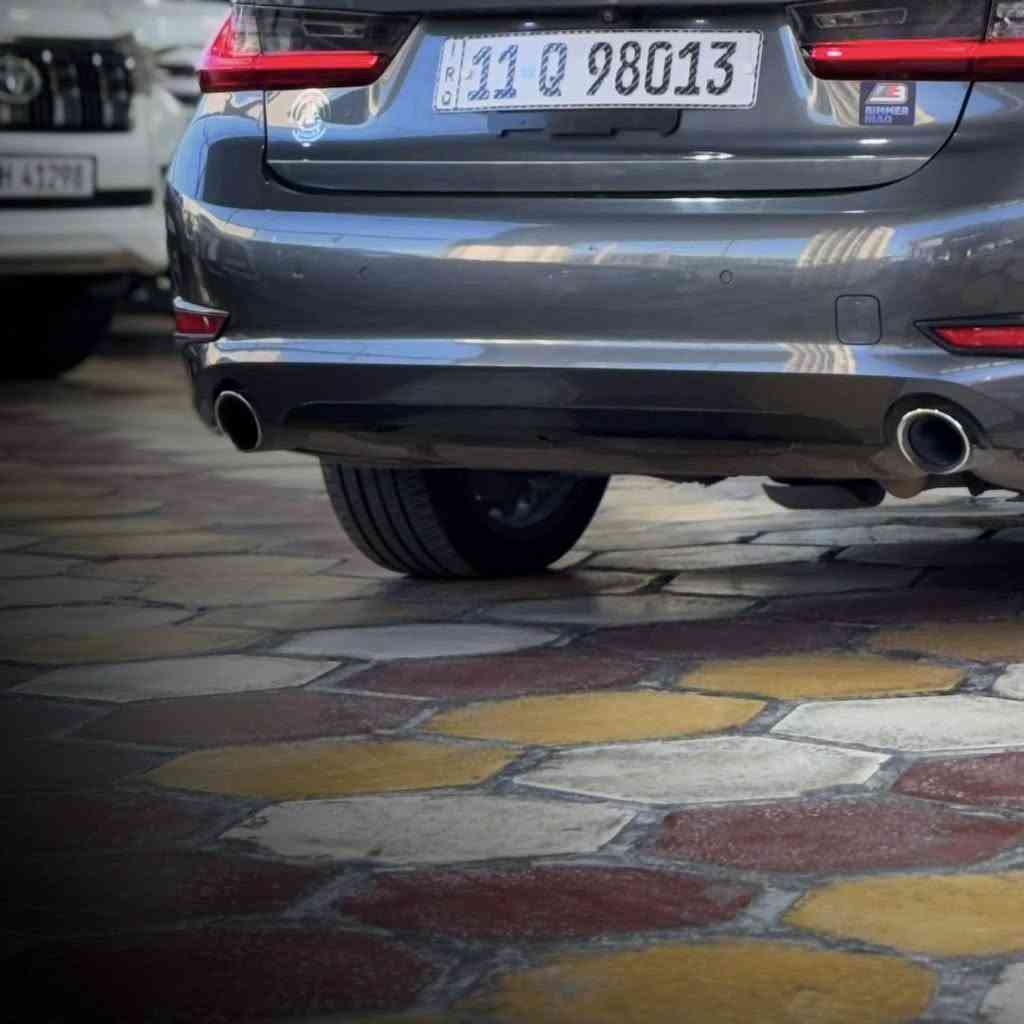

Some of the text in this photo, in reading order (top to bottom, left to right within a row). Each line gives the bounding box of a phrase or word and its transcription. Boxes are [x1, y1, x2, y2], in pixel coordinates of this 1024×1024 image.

[466, 40, 737, 102] 11 Q 98013
